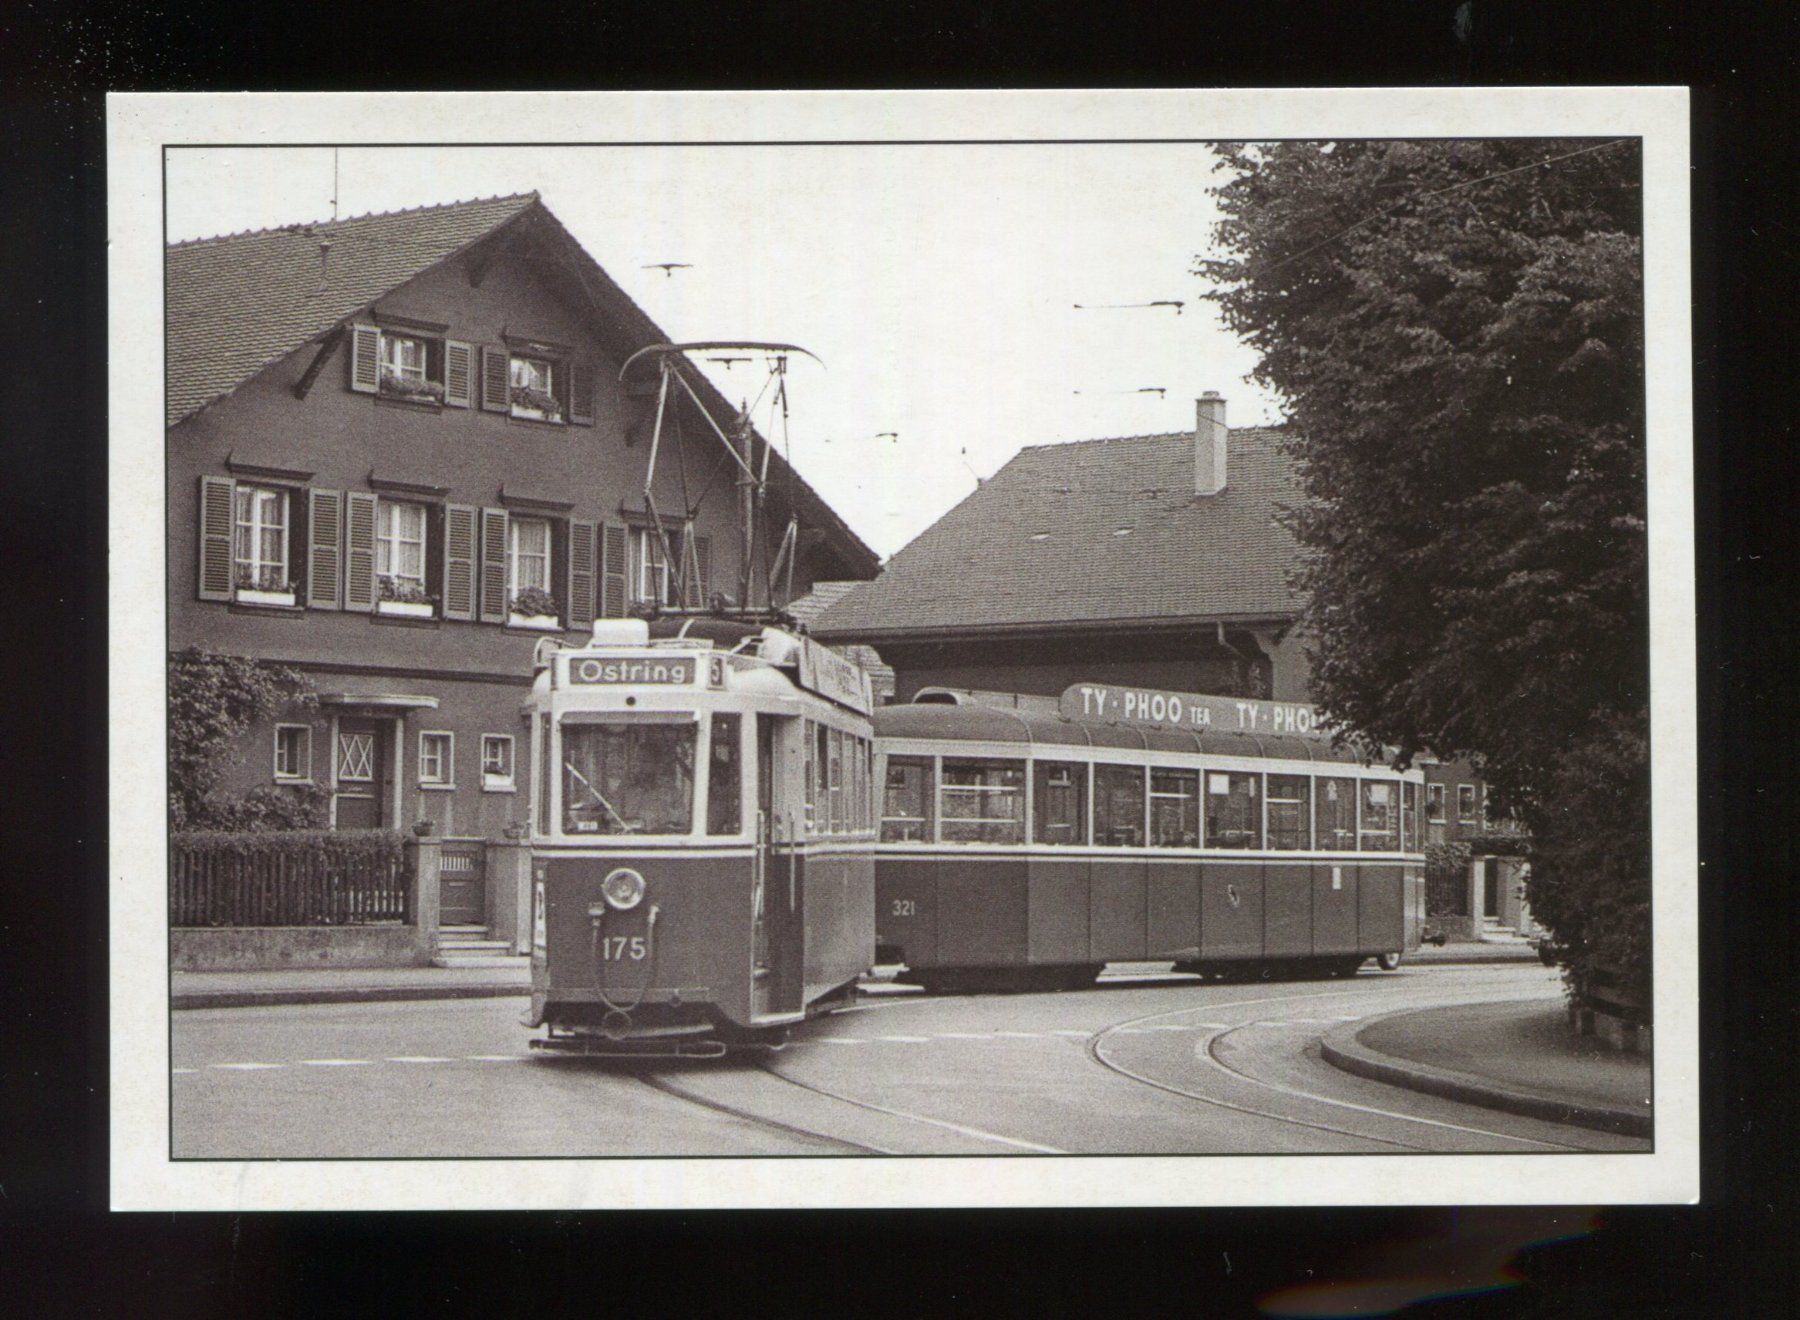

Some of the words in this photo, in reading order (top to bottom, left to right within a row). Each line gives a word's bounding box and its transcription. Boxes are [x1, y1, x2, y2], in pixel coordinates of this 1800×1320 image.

[579, 659, 686, 684] Ostring
[1190, 706, 1211, 725] TEA
[892, 899, 915, 916] 321
[603, 936, 646, 961] 175
